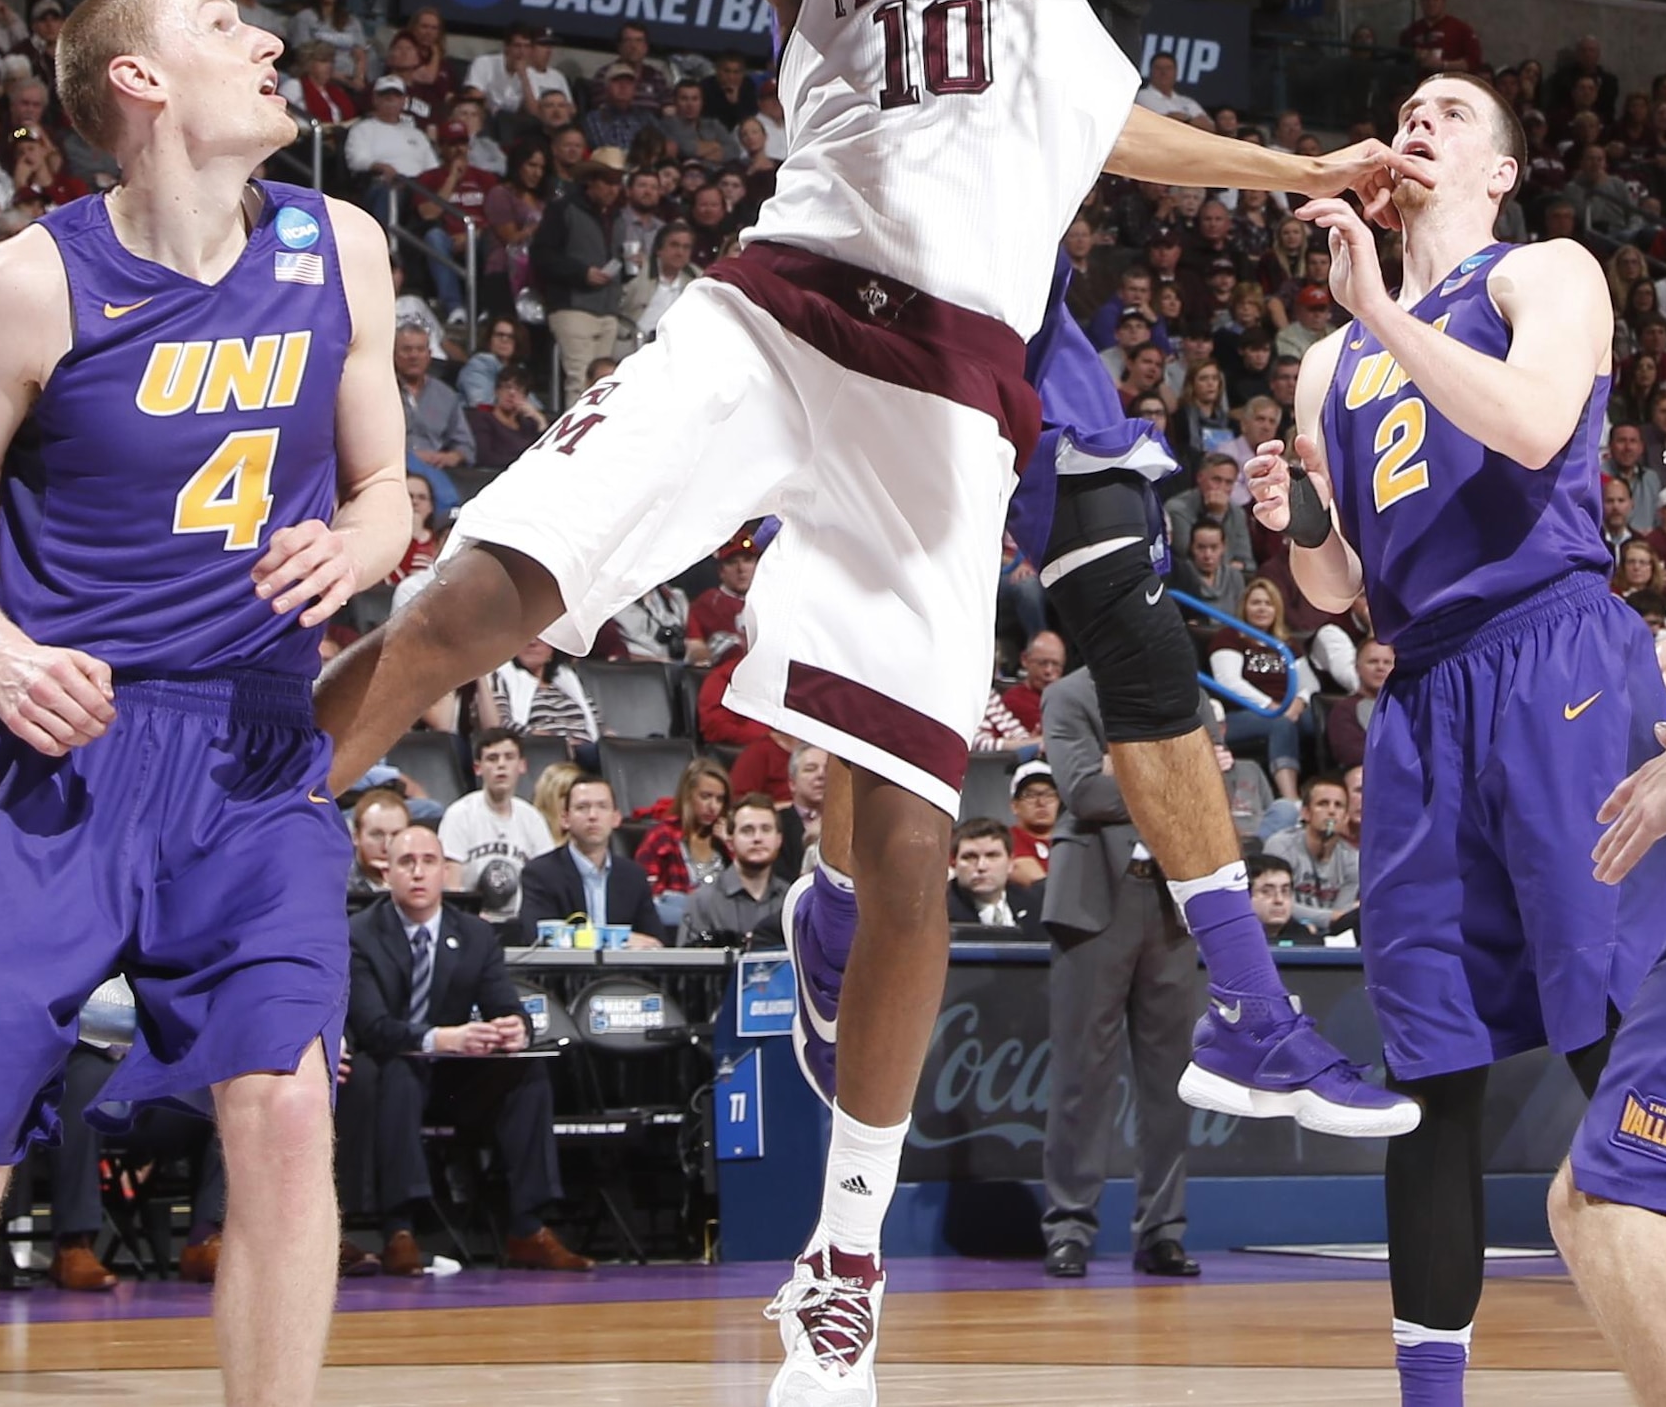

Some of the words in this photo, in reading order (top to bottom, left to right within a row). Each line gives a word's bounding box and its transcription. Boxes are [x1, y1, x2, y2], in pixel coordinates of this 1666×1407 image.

[135, 330, 312, 417] UNI
[173, 428, 281, 552] 4
[1373, 396, 1430, 515] 2
